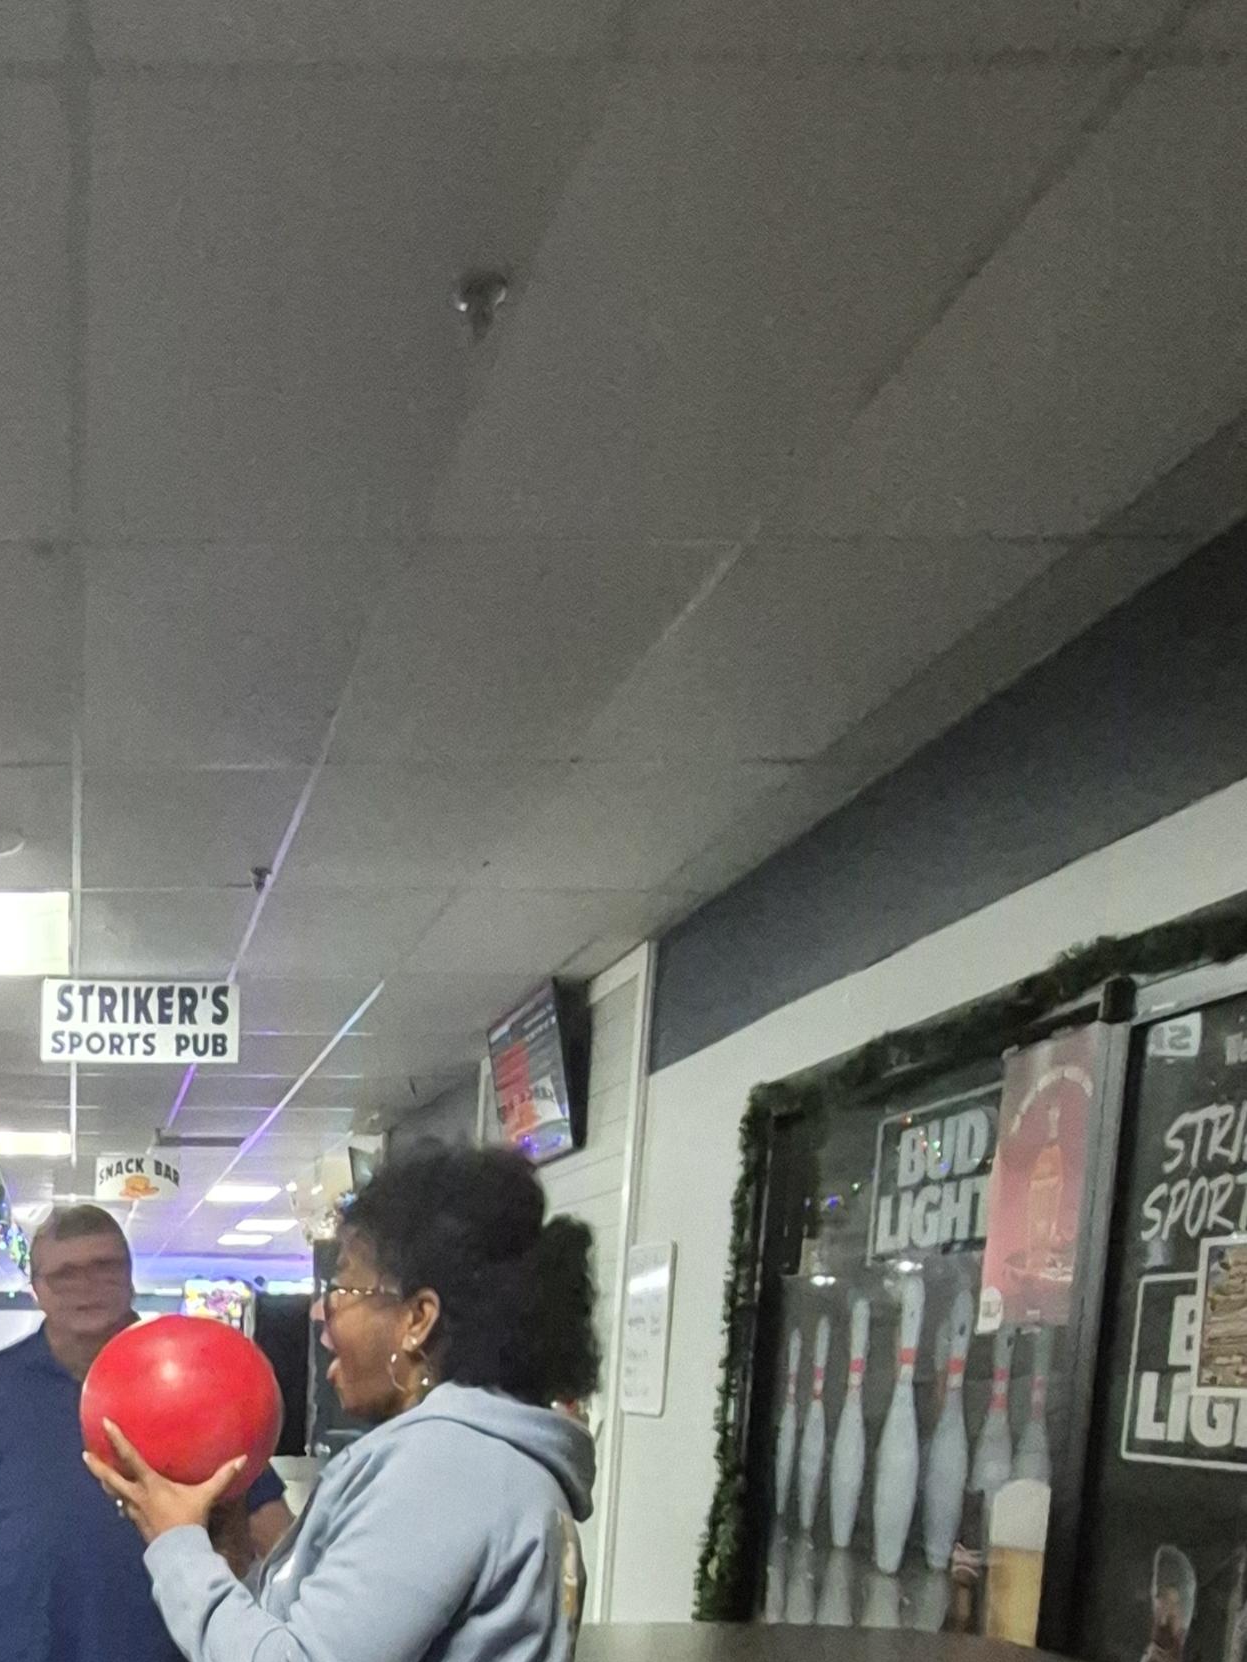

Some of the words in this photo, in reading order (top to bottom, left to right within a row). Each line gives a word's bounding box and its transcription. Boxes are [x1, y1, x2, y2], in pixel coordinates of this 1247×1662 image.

[56, 984, 229, 1026] STRIKER'S
[50, 1030, 156, 1056] SPORTS
[175, 1033, 228, 1057] PUB
[897, 1108, 989, 1188] BUD
[99, 1158, 144, 1186] SNACK
[154, 1160, 180, 1188] BAR
[876, 1174, 990, 1254] LIGHT
